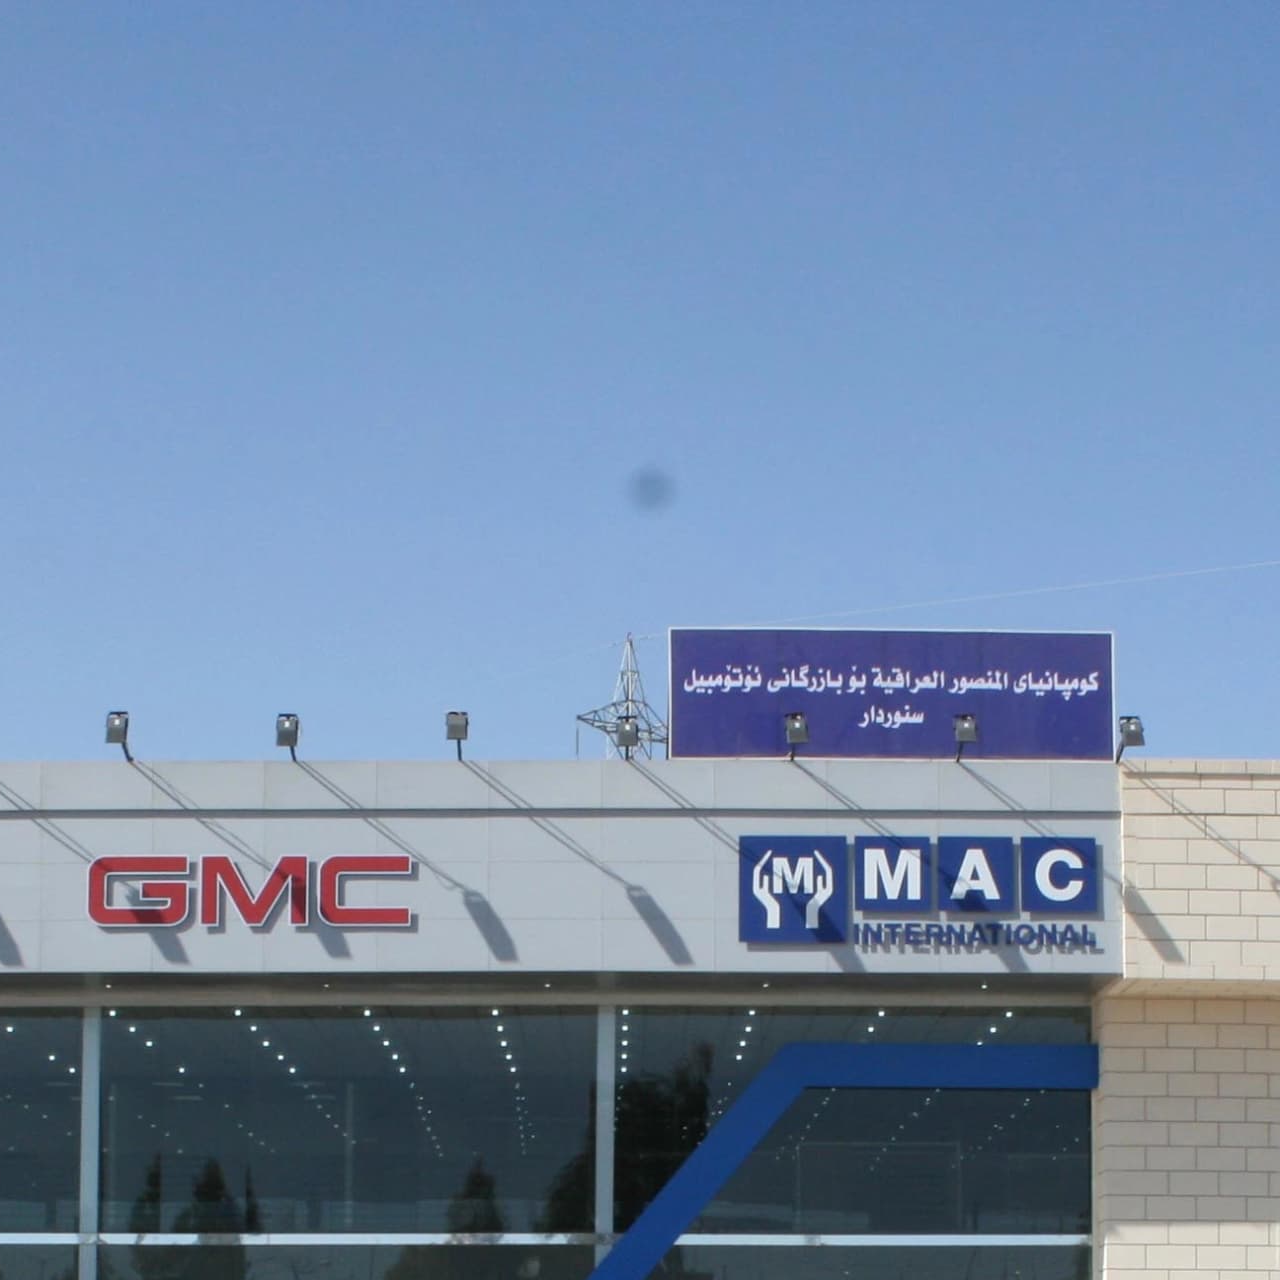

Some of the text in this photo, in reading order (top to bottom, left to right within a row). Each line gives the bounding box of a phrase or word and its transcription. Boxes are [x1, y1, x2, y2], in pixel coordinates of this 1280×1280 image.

[948, 670, 1008, 694] المنصور
[86, 855, 412, 927] GMC
[863, 848, 1085, 902] MAC
[853, 922, 1097, 947] INTERNATIONAL
